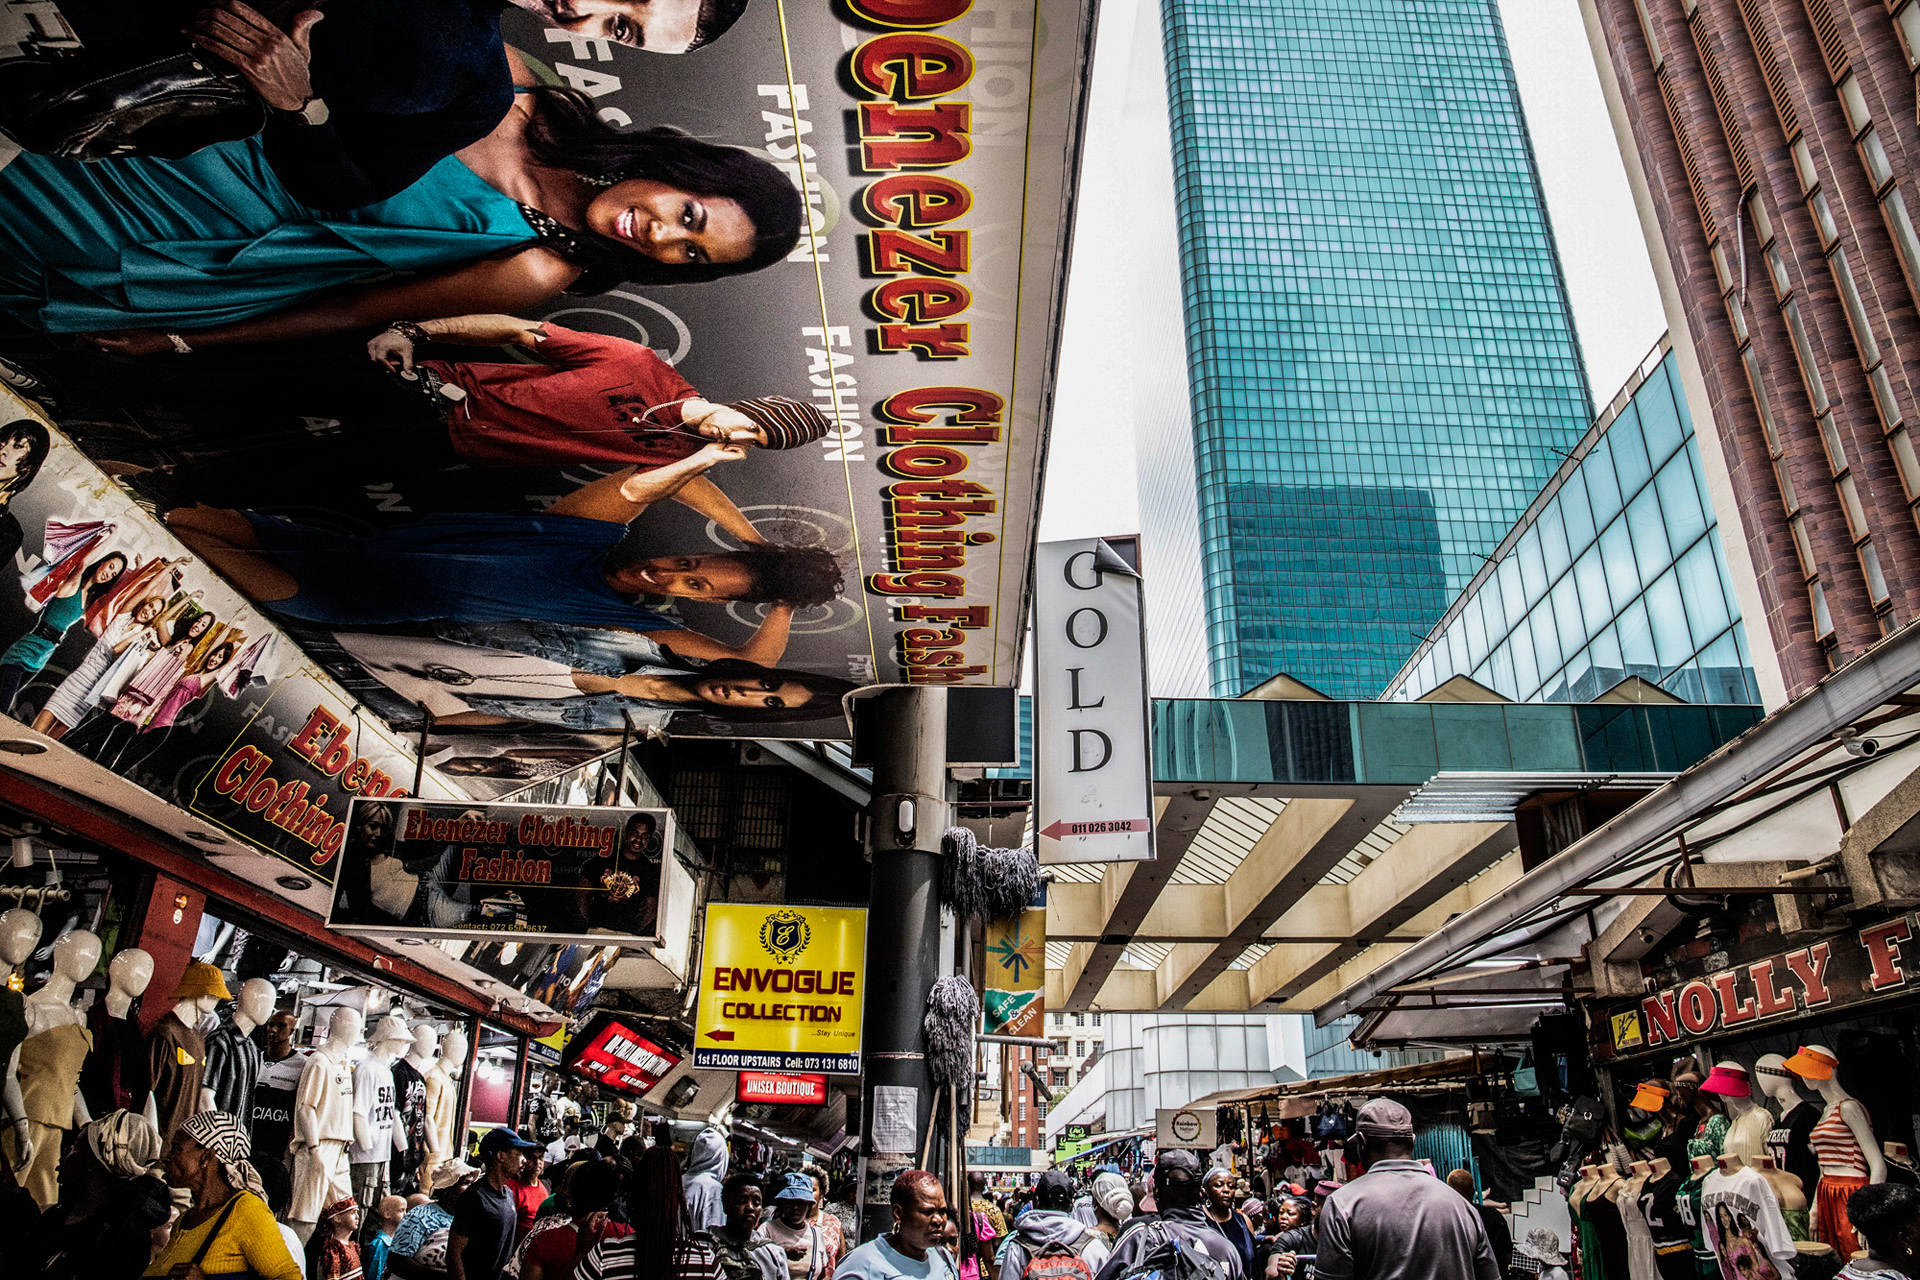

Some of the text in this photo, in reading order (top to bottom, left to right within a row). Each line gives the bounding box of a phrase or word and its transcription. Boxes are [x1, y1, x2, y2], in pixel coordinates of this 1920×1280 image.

[801, 325, 866, 462] FASHION
[871, 386, 1006, 596] Clothing
[1063, 550, 1113, 773] GOLD
[214, 744, 346, 866] Clothing
[403, 808, 616, 858] Ebenezer Clothing
[1071, 820, 1132, 835] 011 026 3042
[459, 847, 552, 884] Fashion
[490, 923, 506, 932] 072
[713, 966, 856, 996] ENVOGUE
[1642, 941, 1831, 1046] NOLLY
[722, 1002, 842, 1023] COLLECTION
[992, 995, 1016, 1018] SAFE
[1008, 1009, 1019, 1019] &
[833, 1030, 856, 1038] Unique
[1008, 1007, 1038, 1036] CLEAN
[698, 1053, 858, 1070] 1st FLOOR UPSTAIRS Cell: 073 131 6810
[746, 1079, 815, 1097] UNISEX BOUTIQUE
